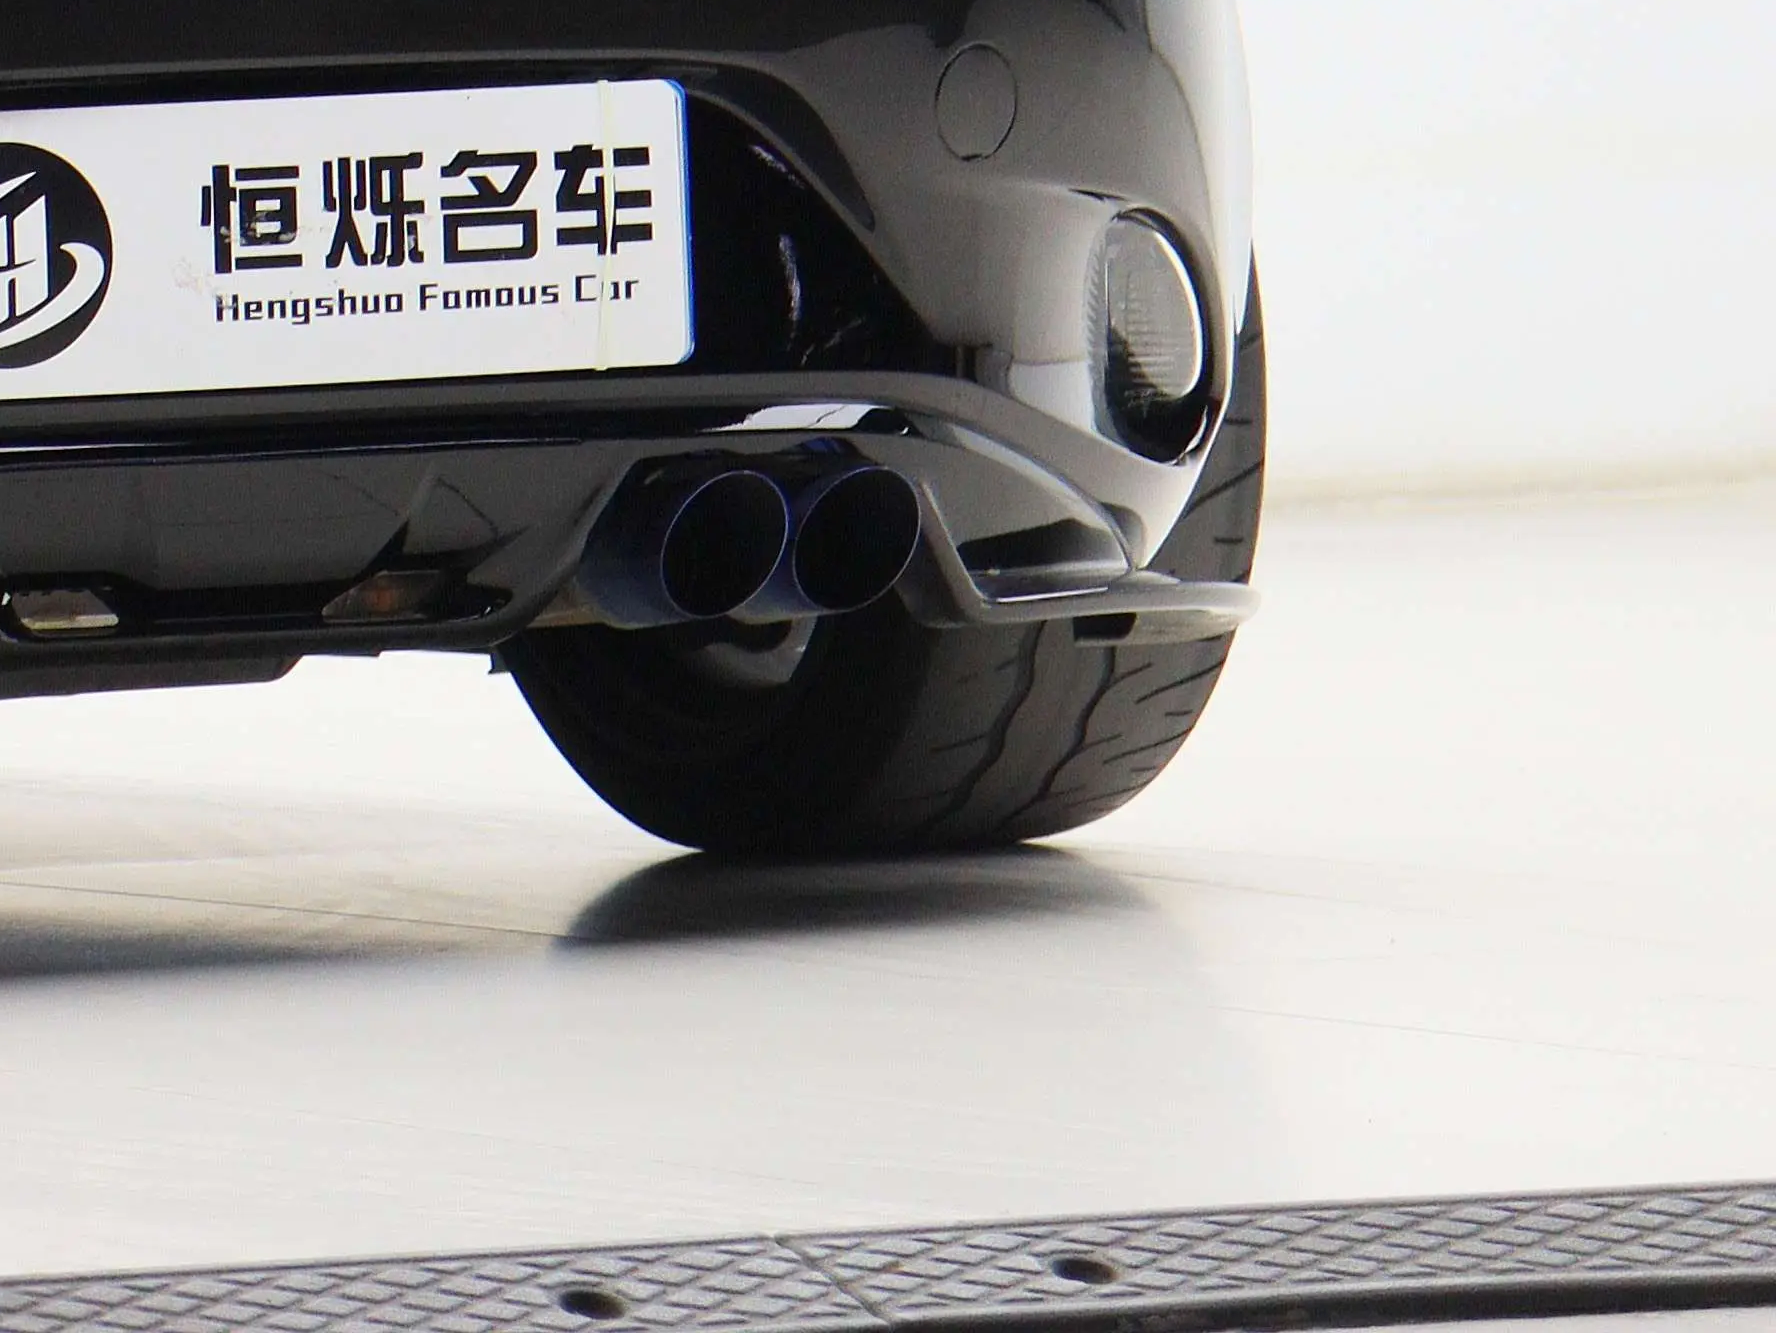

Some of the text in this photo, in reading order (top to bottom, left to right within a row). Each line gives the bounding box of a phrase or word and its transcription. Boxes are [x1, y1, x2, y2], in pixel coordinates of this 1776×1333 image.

[201, 144, 653, 274] 恒烁名车
[215, 289, 404, 325] Hengshuo
[419, 283, 560, 311] Famous
